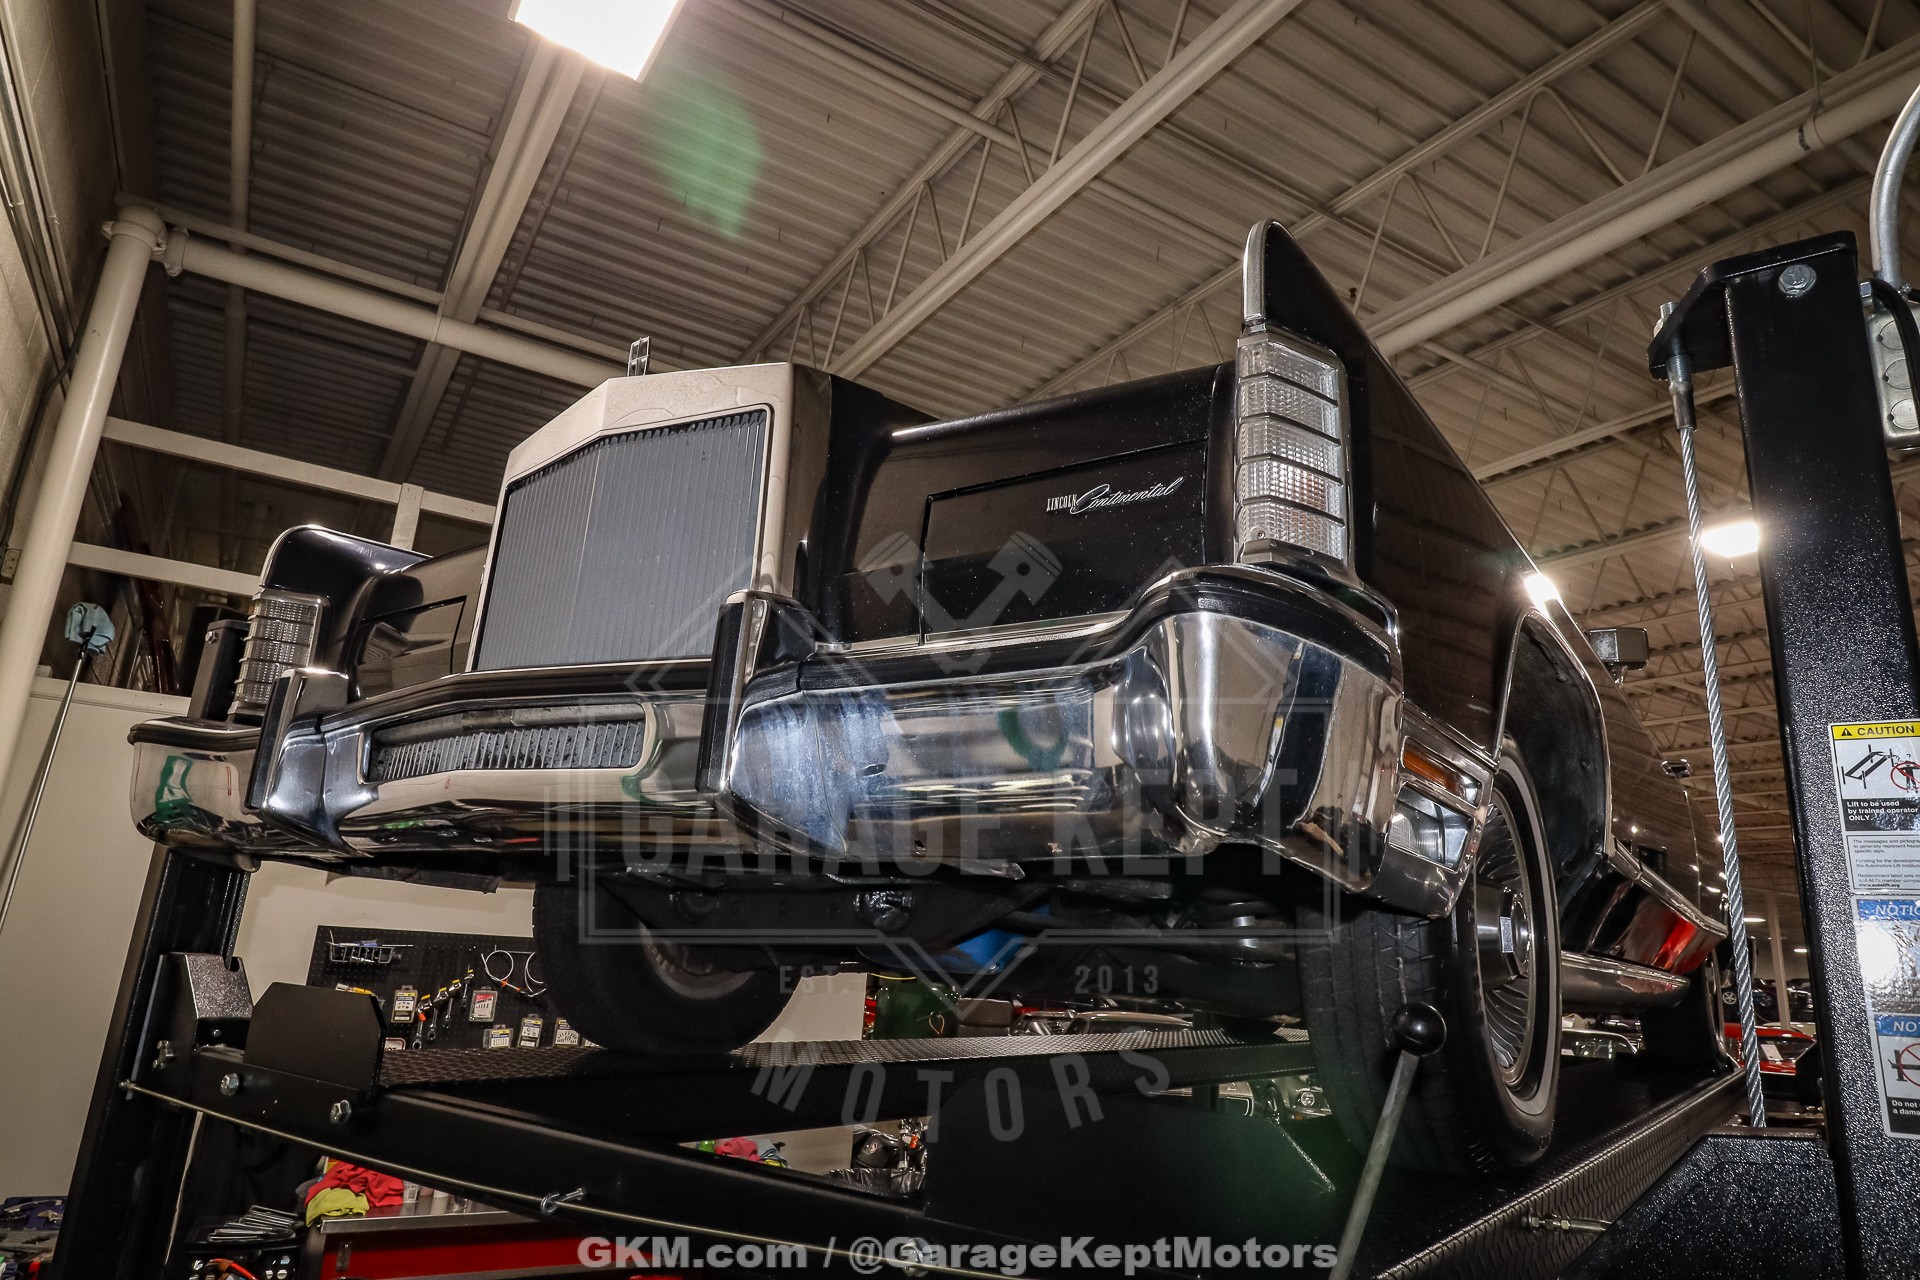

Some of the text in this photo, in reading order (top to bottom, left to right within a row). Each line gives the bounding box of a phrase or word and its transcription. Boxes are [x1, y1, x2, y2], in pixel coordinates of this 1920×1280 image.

[1046, 476, 1183, 514] LINCOLN Continental
[1857, 725, 1915, 736] CAUTION
